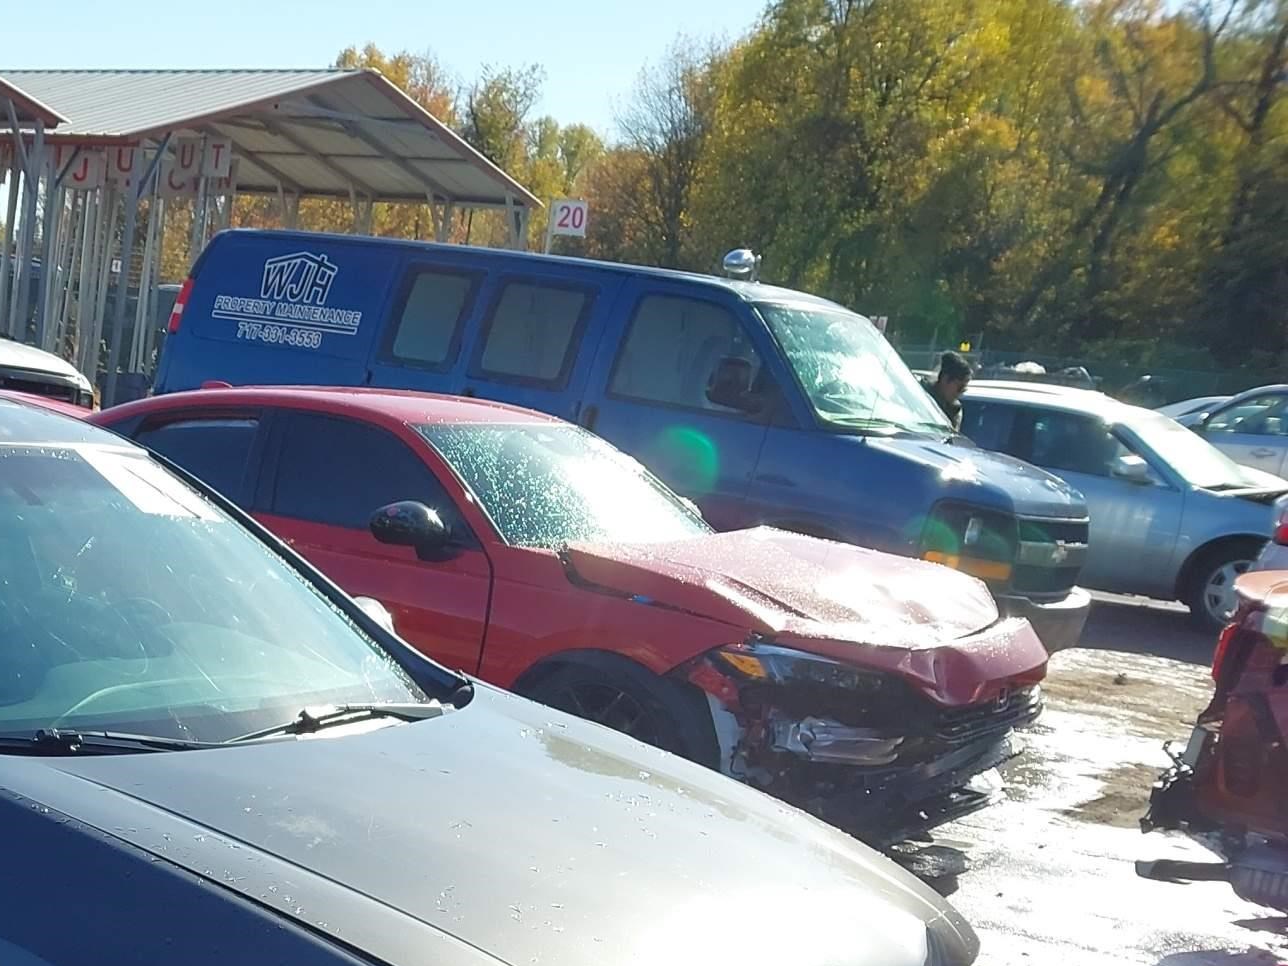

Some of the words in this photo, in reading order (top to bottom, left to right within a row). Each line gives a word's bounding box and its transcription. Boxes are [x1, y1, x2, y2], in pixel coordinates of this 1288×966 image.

[213, 144, 224, 169] T
[557, 205, 584, 229] 20
[261, 257, 335, 305] WJH
[214, 295, 275, 315] PROPERTY
[275, 302, 362, 326] MAINTENANCE
